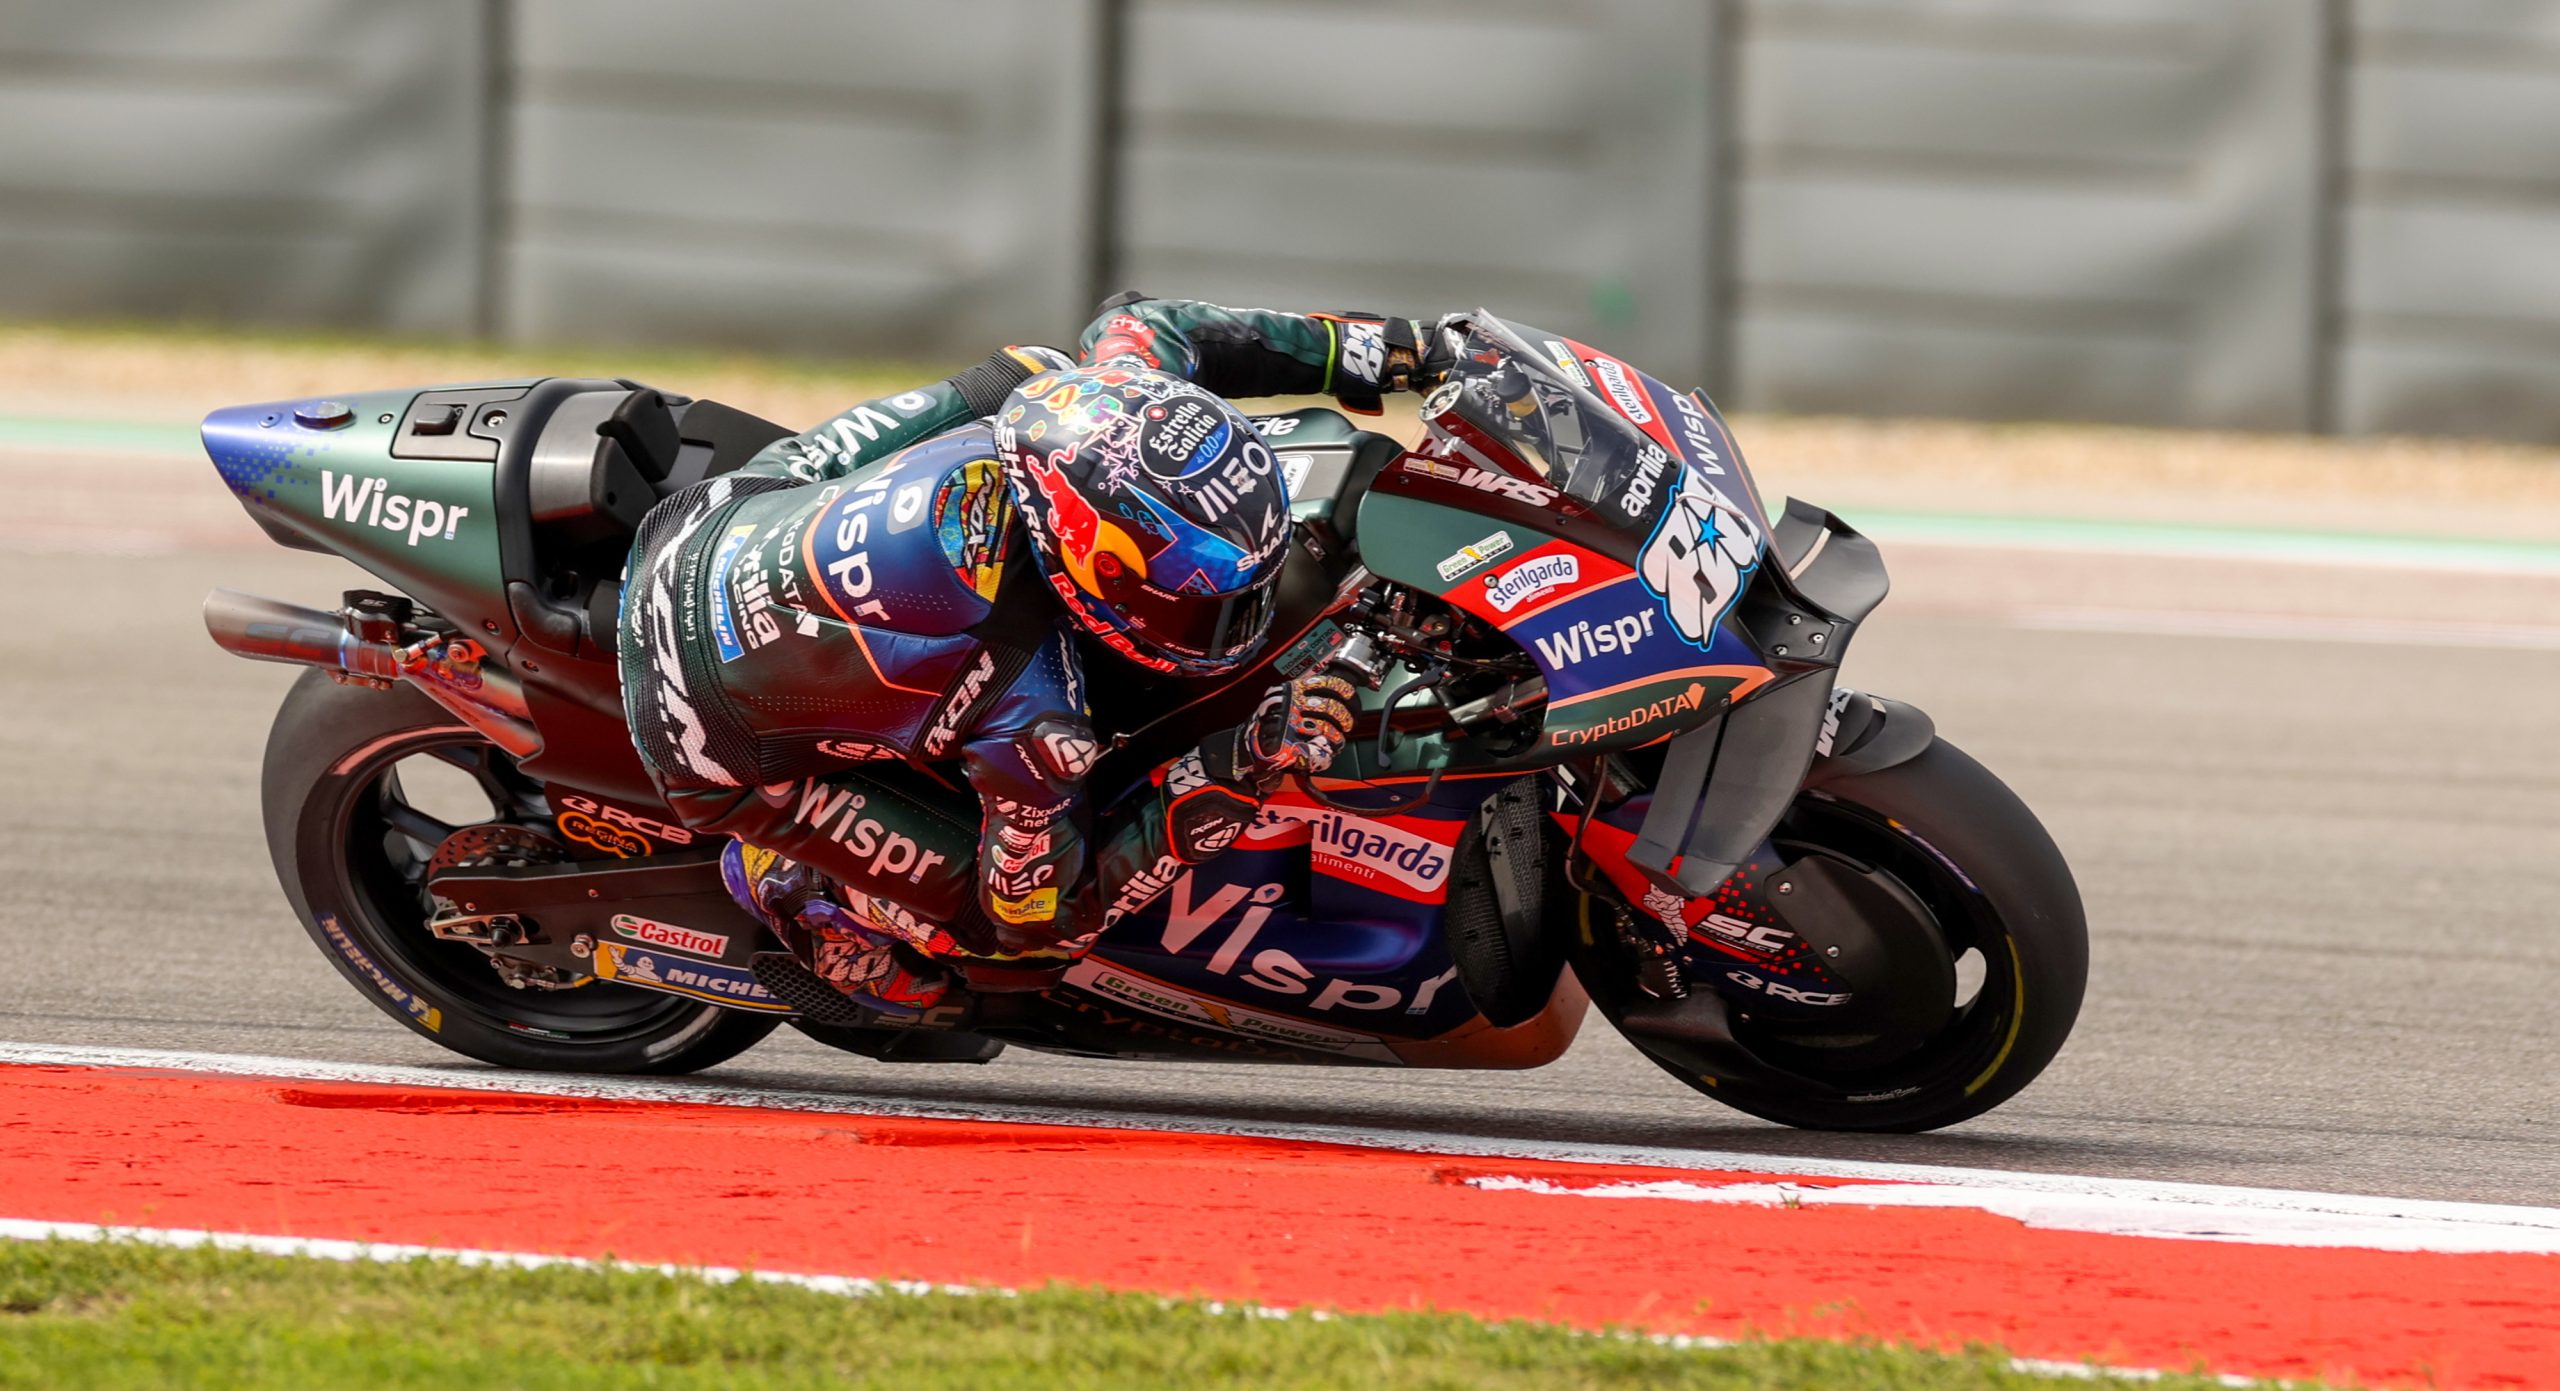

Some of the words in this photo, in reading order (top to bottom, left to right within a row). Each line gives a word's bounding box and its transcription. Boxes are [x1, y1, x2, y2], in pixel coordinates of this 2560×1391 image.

[1149, 402, 1202, 455] Estrella
[1168, 414, 1217, 461] Galicia
[1000, 427, 1055, 555] SHARK
[1457, 467, 1559, 507] WRS
[1620, 443, 1668, 518] aprilia
[321, 470, 468, 546] Wispr
[713, 557, 733, 646] MICHELIN
[732, 555, 760, 650] ACING
[1493, 556, 1573, 606] sterilgarda
[1049, 571, 1113, 635] Red
[1101, 632, 1178, 673] Bull
[1534, 607, 1655, 671] Wispr
[1551, 692, 1693, 747] CryptoDATA
[571, 820, 637, 851] REGINA
[601, 805, 693, 845] RCB
[794, 776, 945, 884] Wispr
[1310, 853, 1376, 880] alimenti
[640, 922, 722, 956] Castrol
[1700, 913, 1795, 949] SC
[321, 915, 408, 1002] MICHELIN
[666, 968, 779, 999] MICHE
[1104, 974, 1191, 1013] Green
